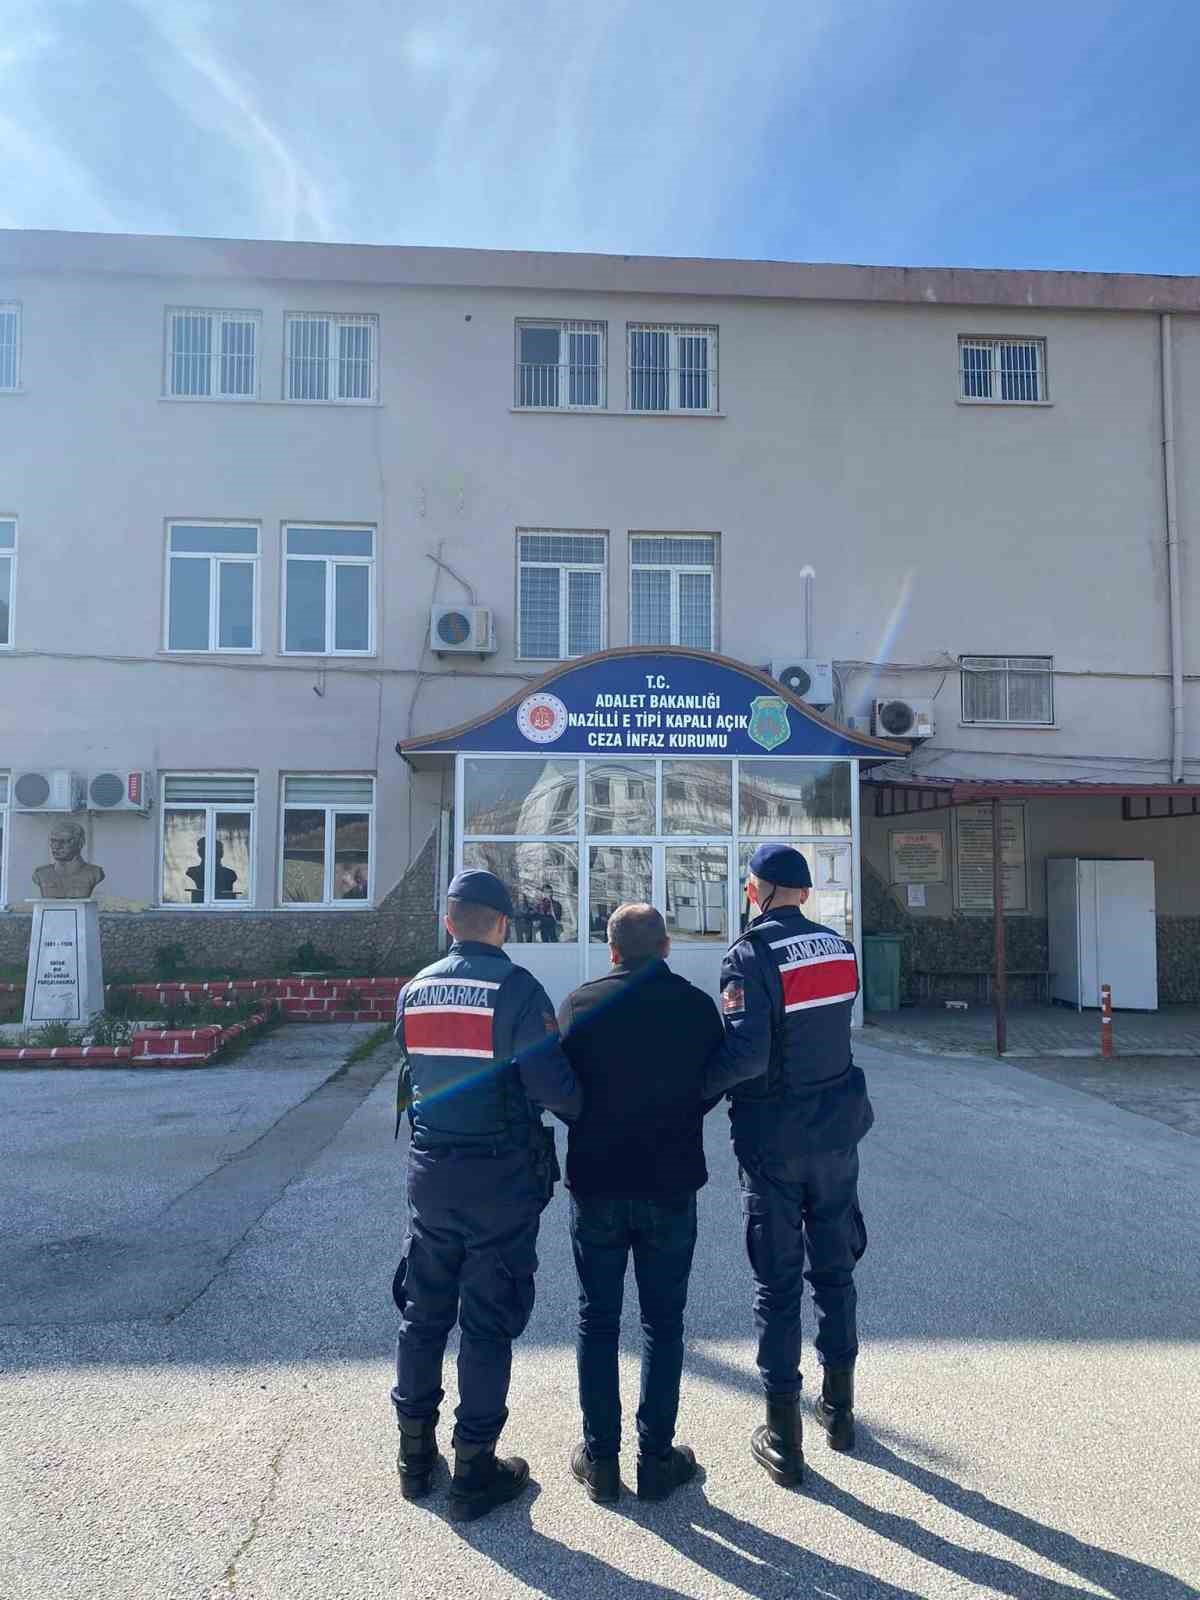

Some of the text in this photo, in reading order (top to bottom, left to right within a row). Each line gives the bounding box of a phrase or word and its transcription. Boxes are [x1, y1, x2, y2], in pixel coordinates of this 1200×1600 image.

[645, 675, 670, 689] T.C.
[595, 692, 721, 709] ADALET BAKANLIĞI
[568, 711, 748, 732] NAZİLLİ E TİPİ KAPALI AÇIK
[588, 730, 728, 748] CEZA İNFAZ KURUMU
[785, 938, 847, 962] JANDARMA
[412, 985, 489, 1007] JANDARMA
